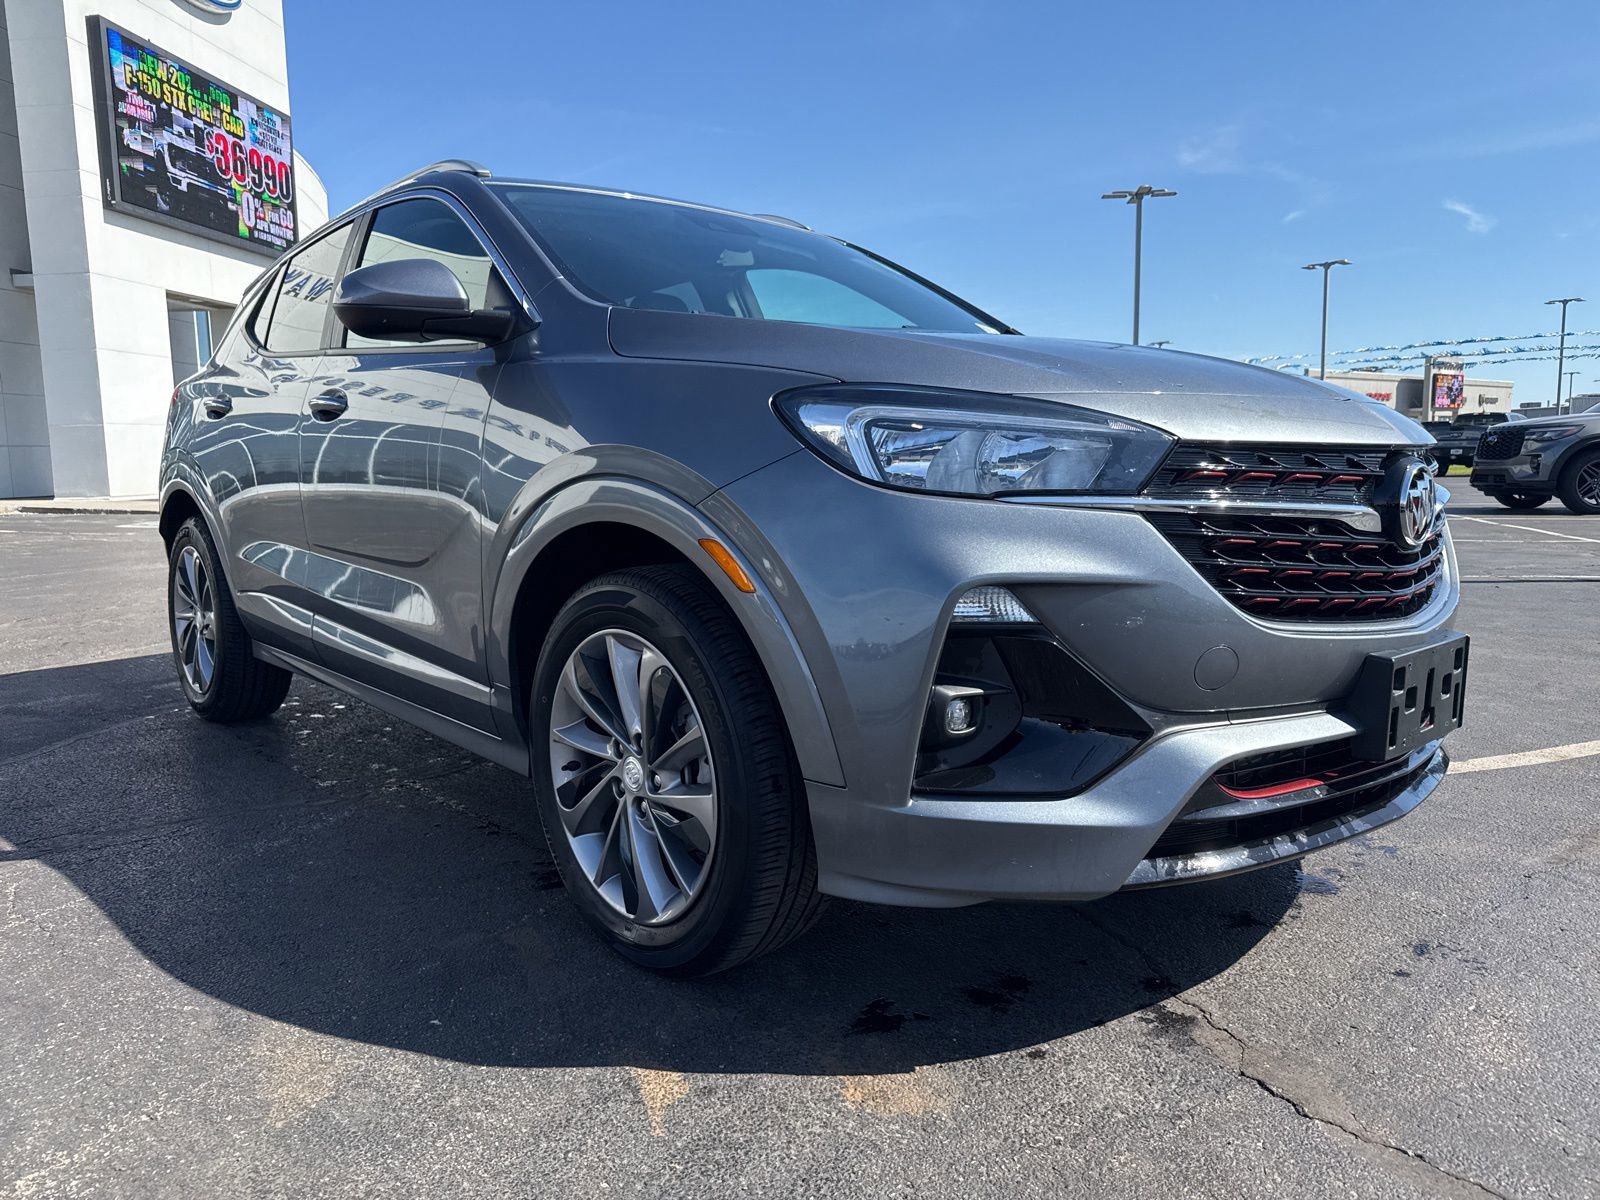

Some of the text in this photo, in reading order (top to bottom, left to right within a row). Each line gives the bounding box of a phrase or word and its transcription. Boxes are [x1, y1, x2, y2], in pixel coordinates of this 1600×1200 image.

[124, 63, 162, 99] F-150
[163, 83, 187, 111] STX
[222, 113, 245, 138] CAB
